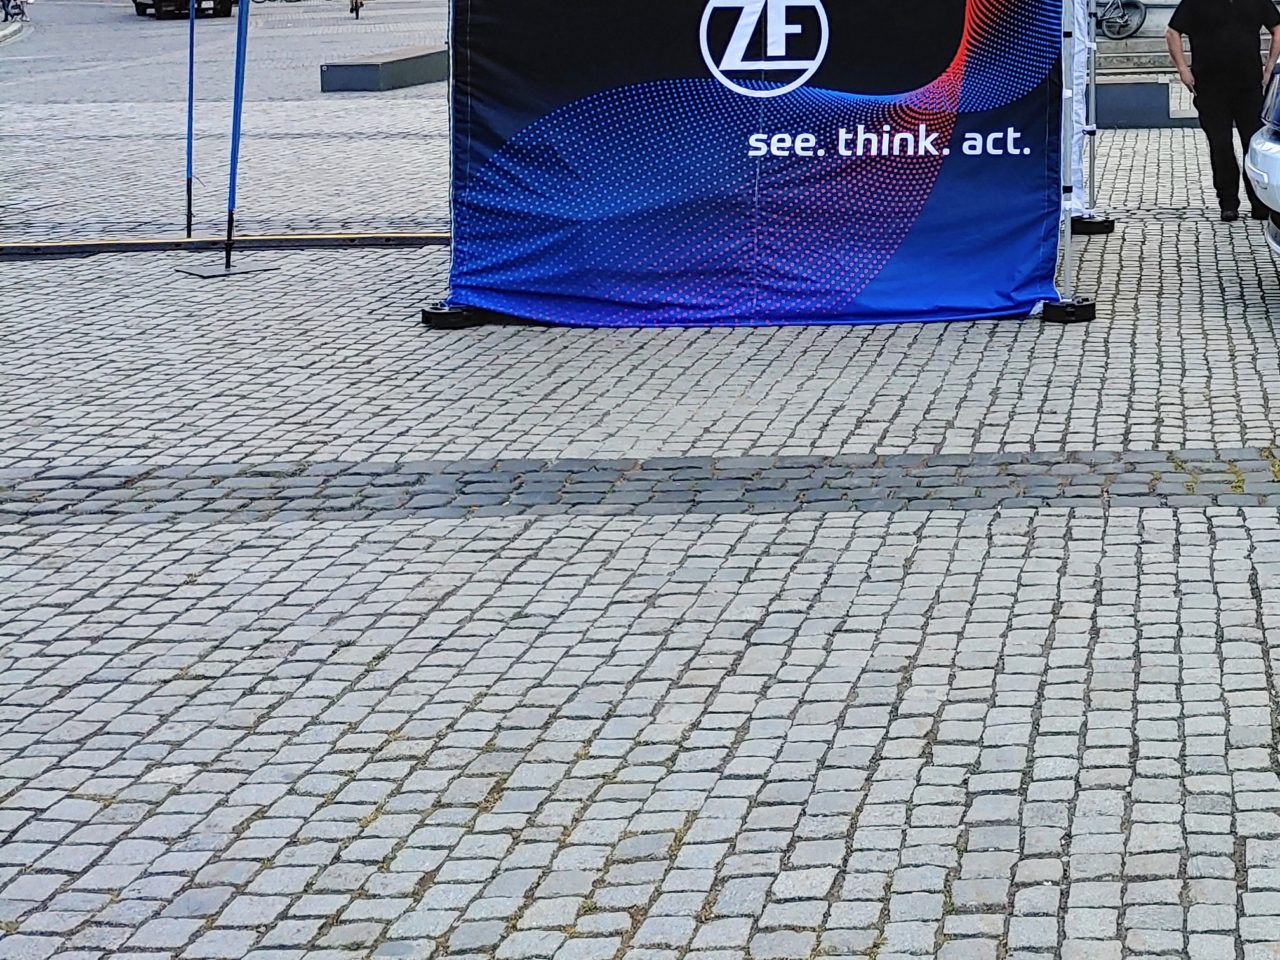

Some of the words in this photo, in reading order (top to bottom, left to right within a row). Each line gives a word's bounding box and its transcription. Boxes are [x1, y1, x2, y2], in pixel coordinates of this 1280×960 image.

[749, 132, 825, 157] see.
[838, 124, 950, 157] think.
[962, 126, 1031, 156] act.
